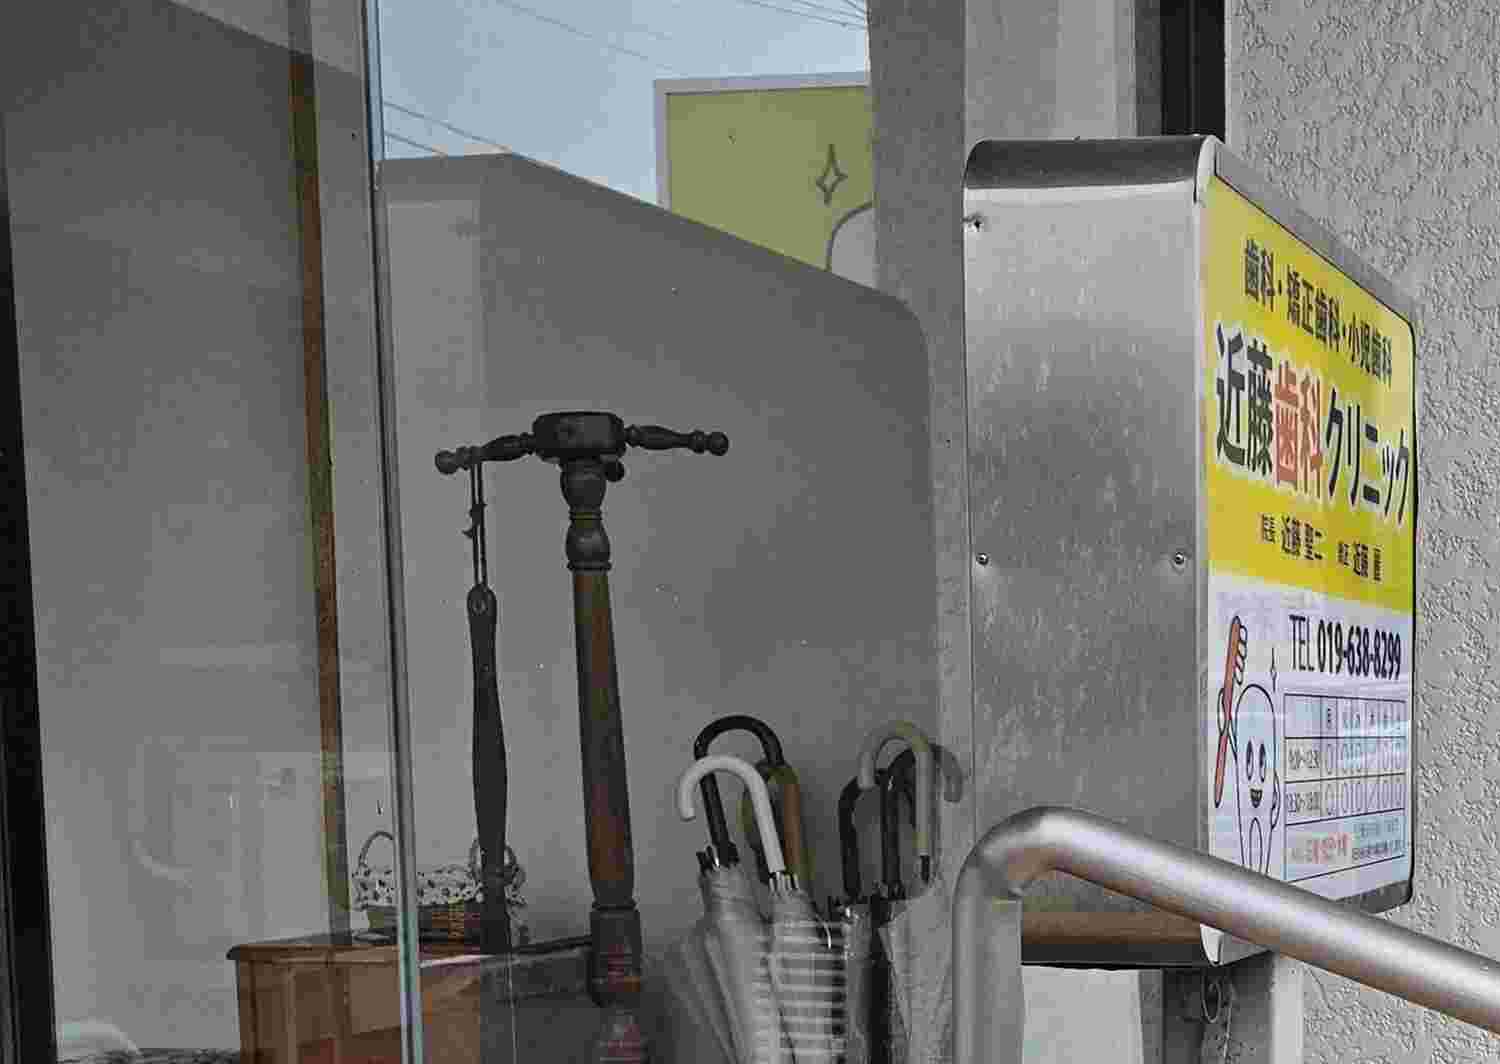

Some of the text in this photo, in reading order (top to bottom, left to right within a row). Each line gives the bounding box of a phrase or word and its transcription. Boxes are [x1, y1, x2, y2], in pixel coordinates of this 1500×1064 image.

[1216, 319, 1409, 525] 近藤歯科クリニック
[1288, 614, 1401, 680] TEL 019-638-8299
